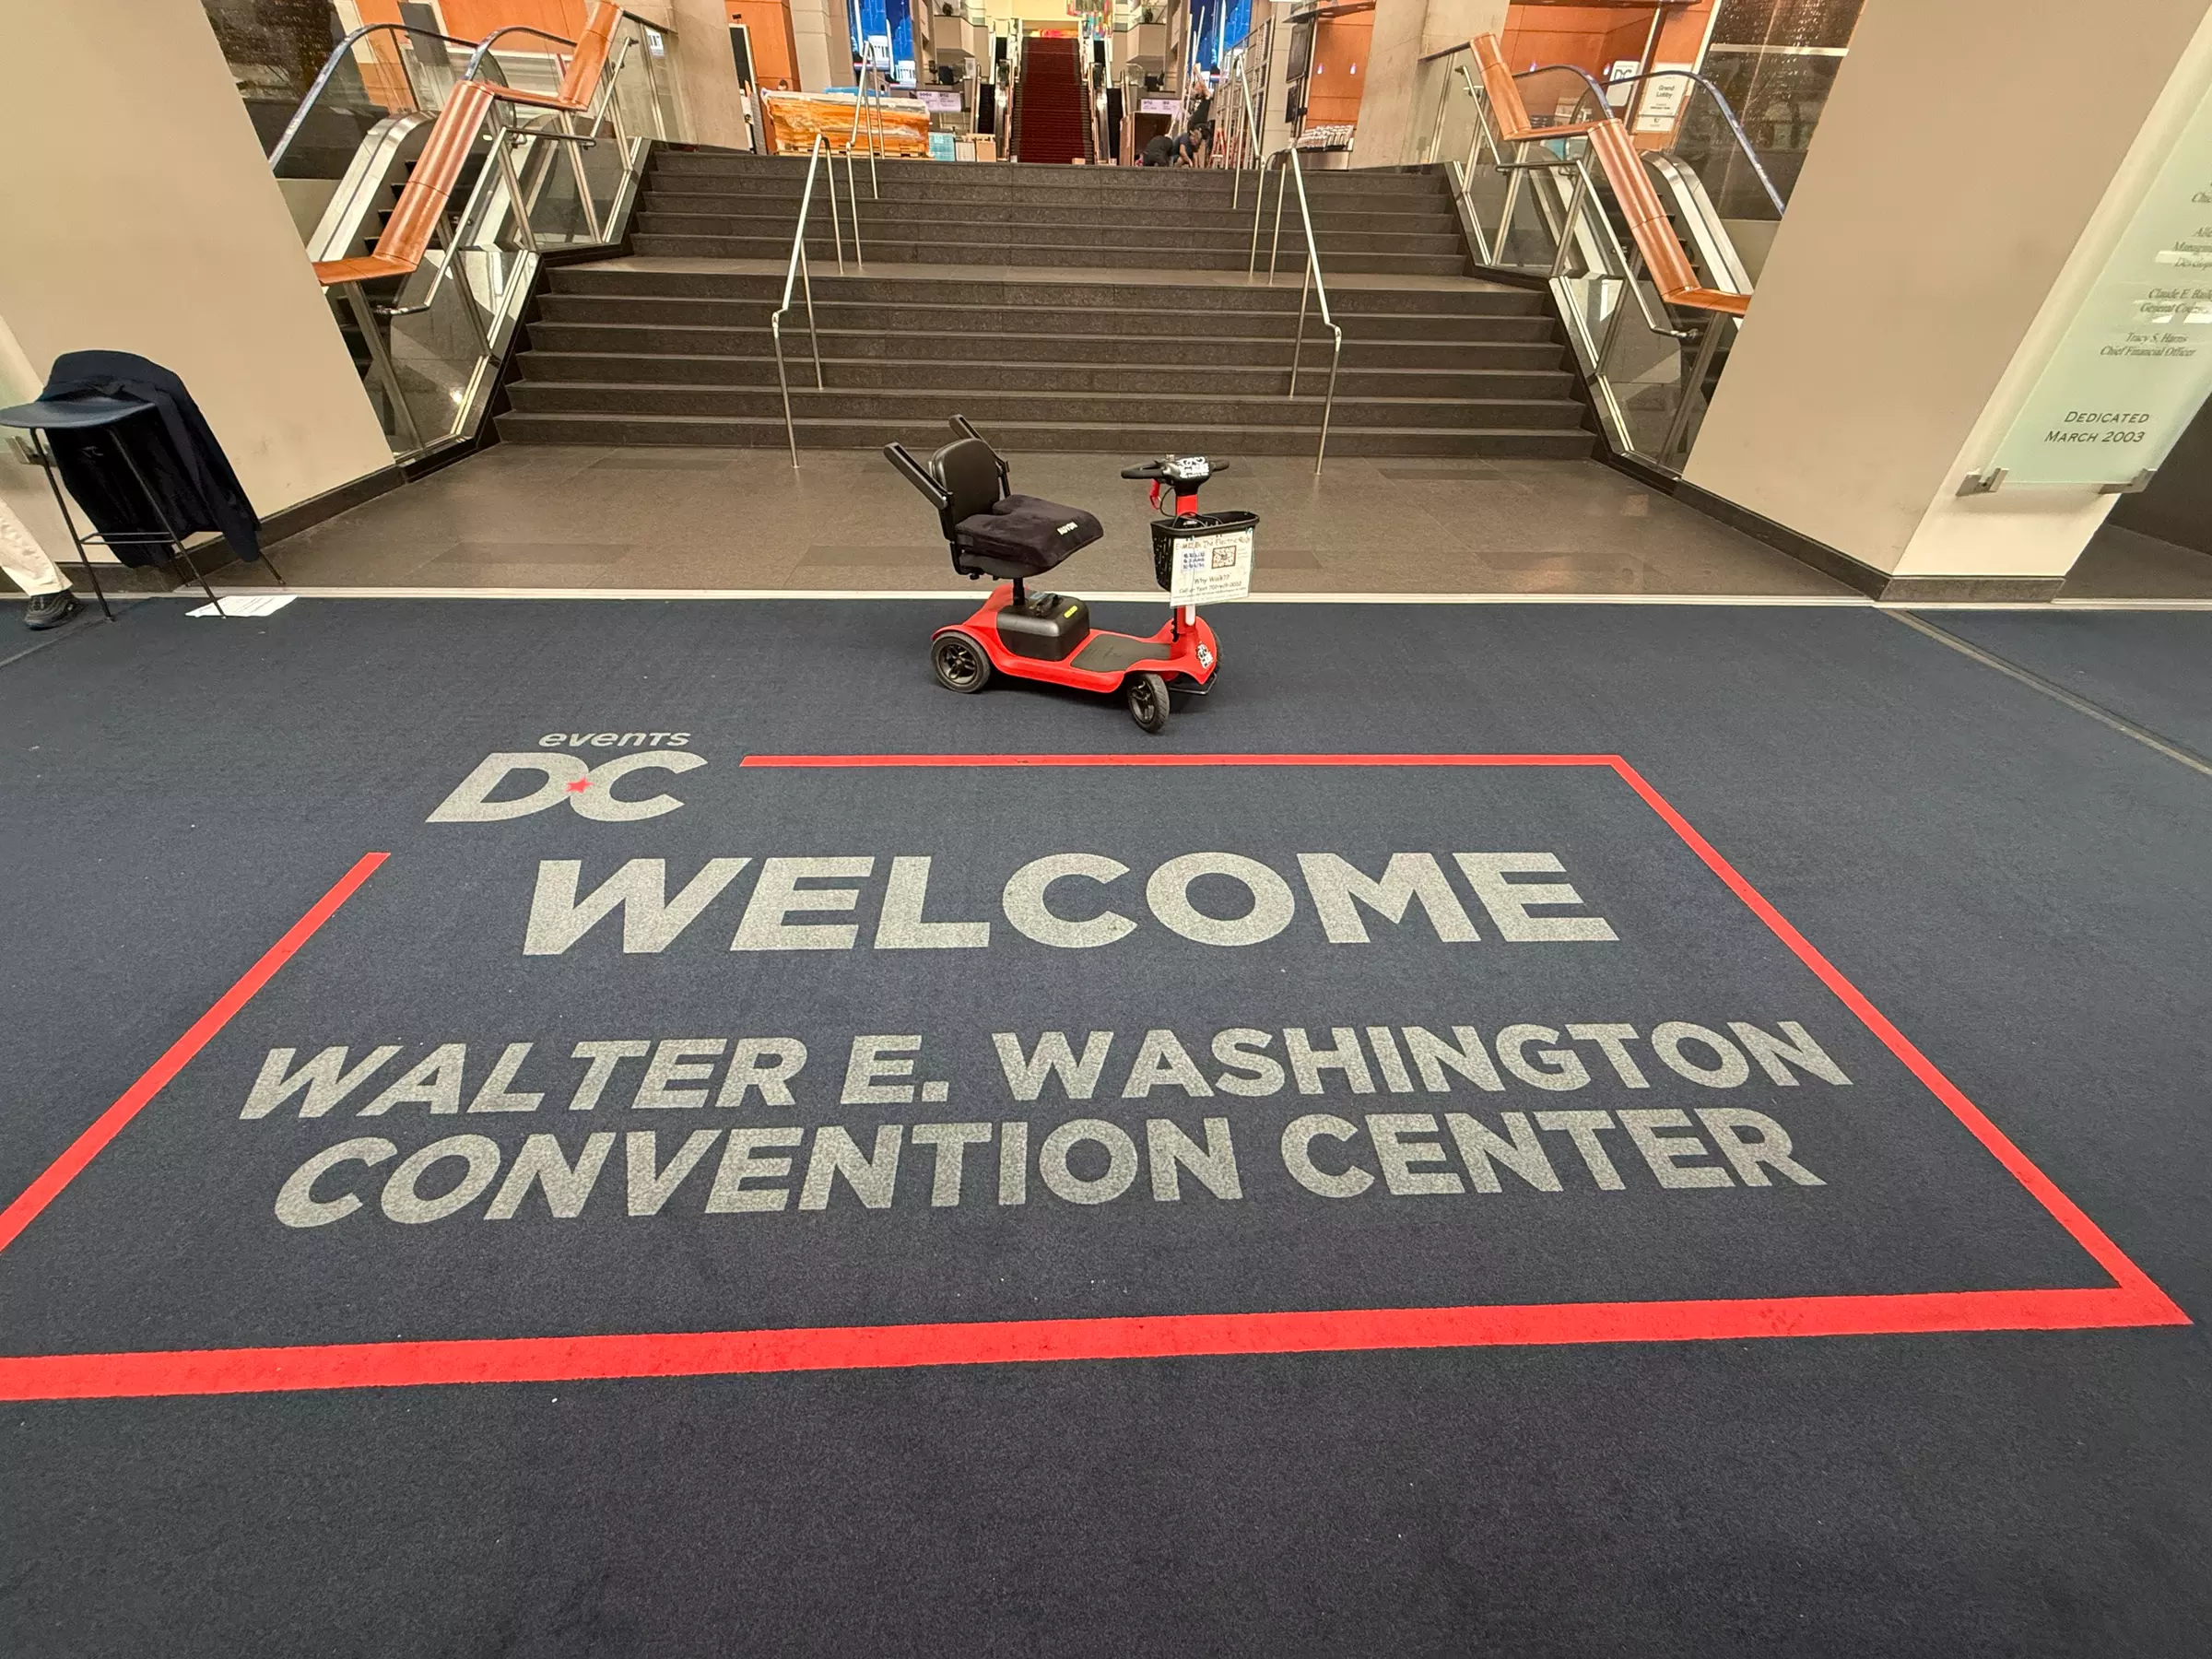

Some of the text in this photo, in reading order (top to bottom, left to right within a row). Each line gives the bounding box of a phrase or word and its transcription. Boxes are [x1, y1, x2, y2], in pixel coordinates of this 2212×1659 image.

[2148, 288, 2179, 299] Claude
[2139, 302, 2175, 313] General
[2125, 333, 2148, 345] Tracy
[2100, 346, 2196, 358] Chief Financial Officer
[2101, 430, 2146, 443] 2003
[538, 731, 691, 748] events
[425, 750, 708, 823] DC
[524, 851, 1619, 956] WELCOME
[240, 1020, 1854, 1120] WALTER E. WASHINGTON
[275, 1107, 1828, 1229] CONVENTION CENTER
